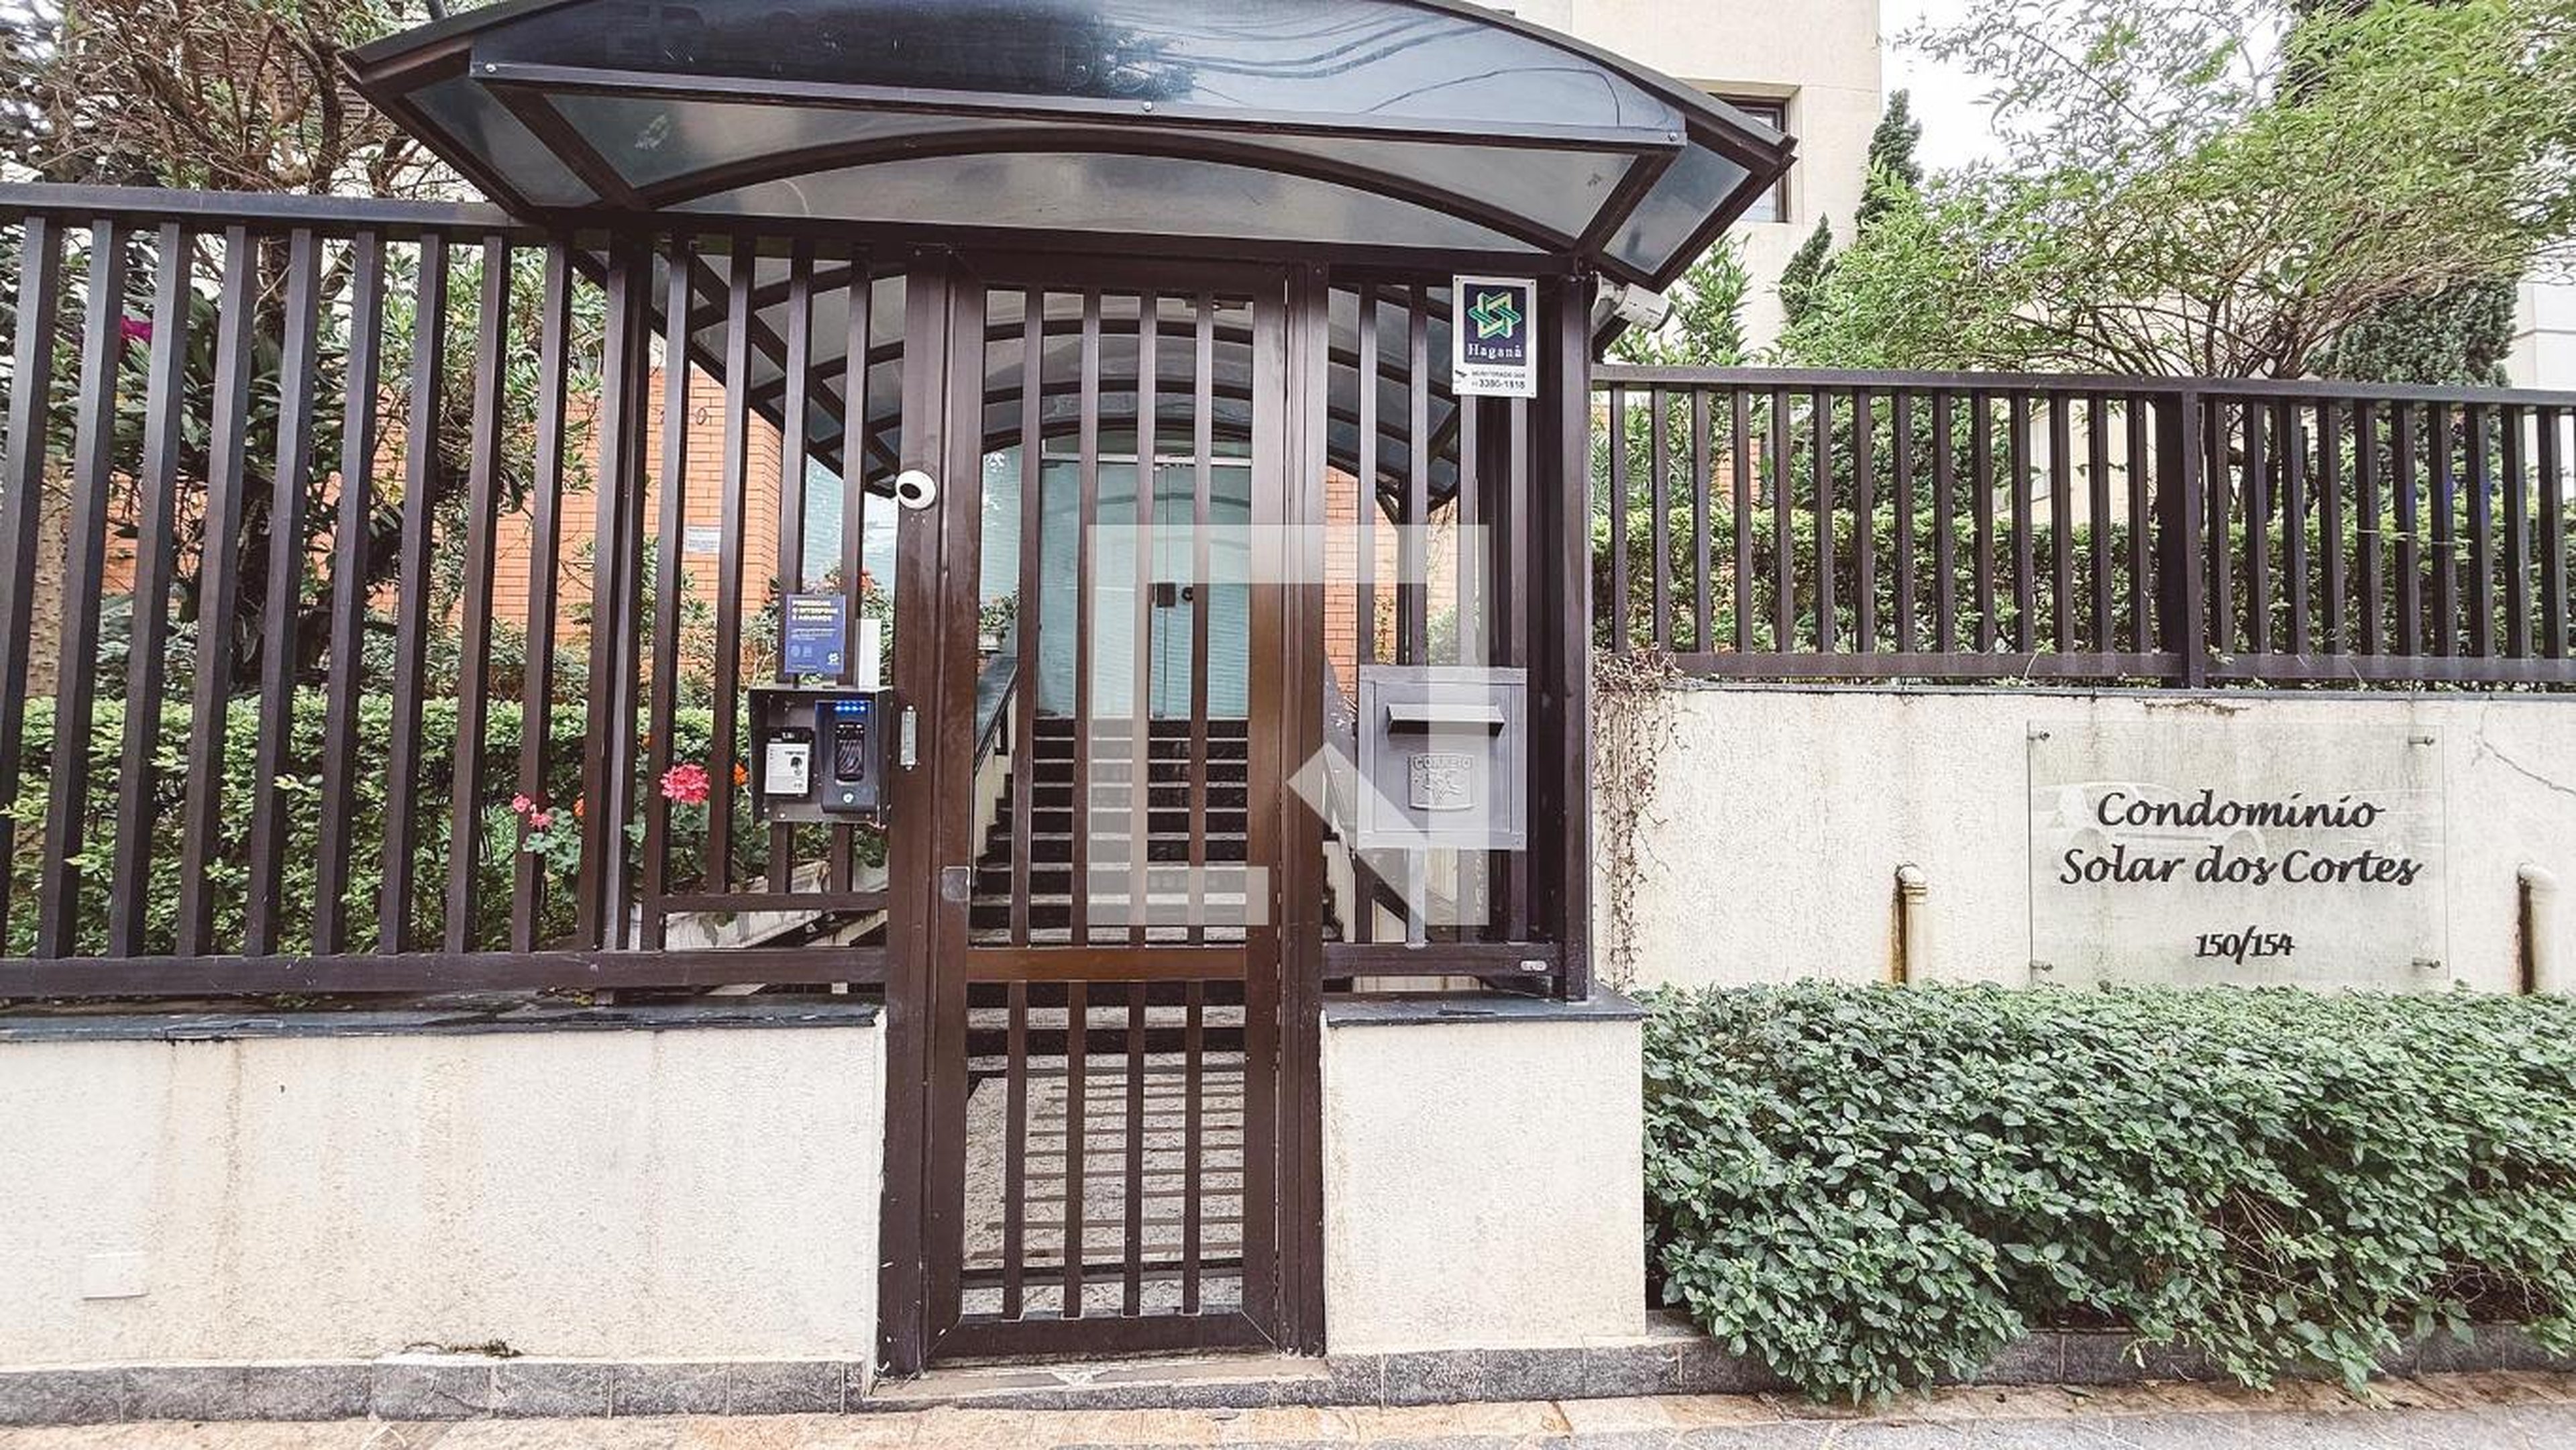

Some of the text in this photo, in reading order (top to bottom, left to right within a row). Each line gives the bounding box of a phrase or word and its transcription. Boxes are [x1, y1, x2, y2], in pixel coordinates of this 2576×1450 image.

[2098, 789, 2385, 828] Condomínio
[2059, 843, 2423, 886] Solar dos Cortes
[2194, 925, 2296, 966] 150/154
